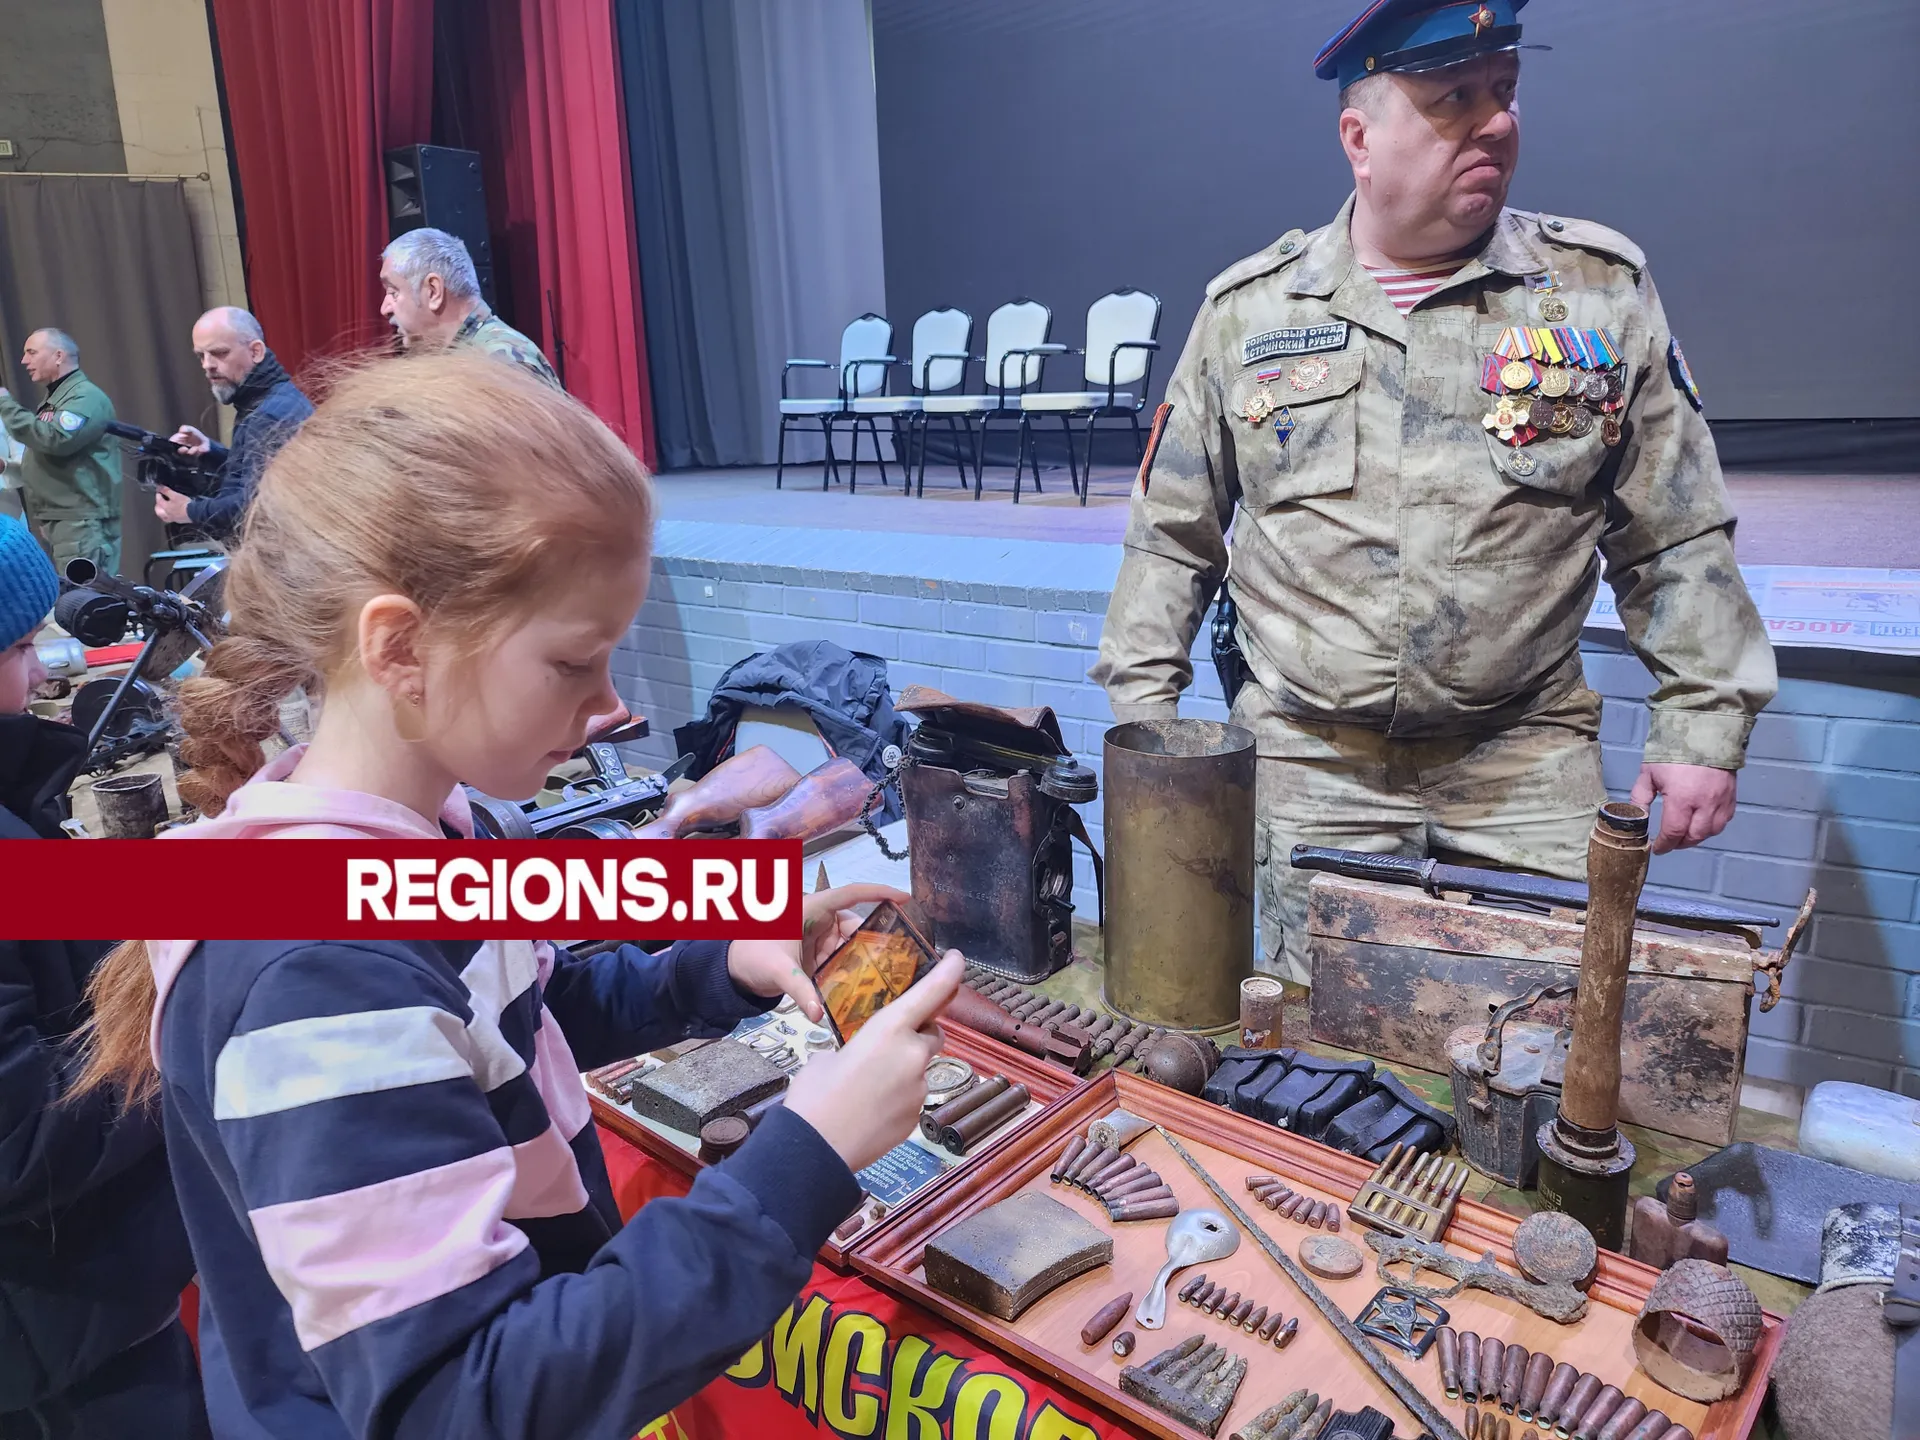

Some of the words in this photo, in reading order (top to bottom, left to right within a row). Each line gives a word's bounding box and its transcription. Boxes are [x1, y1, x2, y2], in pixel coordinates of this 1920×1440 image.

[1244, 340, 1306, 360] ИСТРИНСКИЙ
[1308, 334, 1342, 347] РУБЕЖ
[1245, 329, 1306, 348] ПОИСКОВЫЙ
[1309, 325, 1344, 335] ОТРЯД
[1763, 619, 1851, 634] ДОСА
